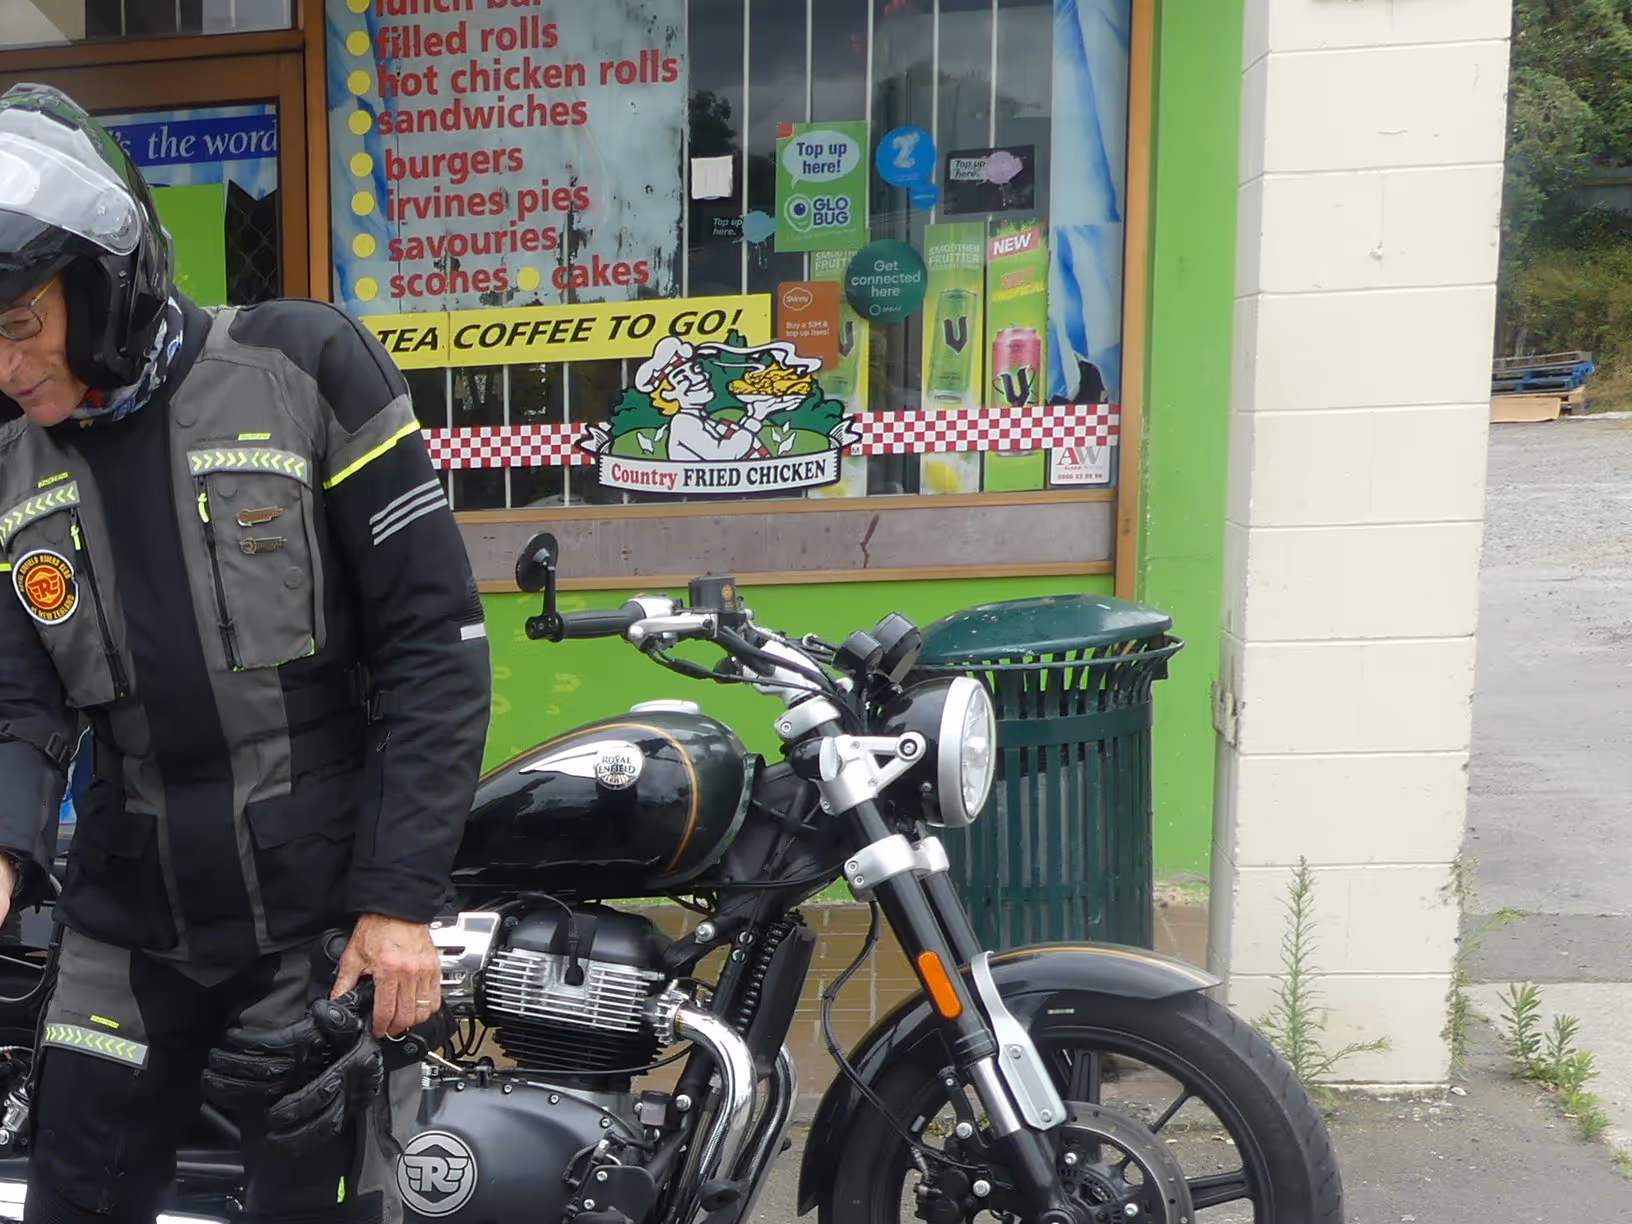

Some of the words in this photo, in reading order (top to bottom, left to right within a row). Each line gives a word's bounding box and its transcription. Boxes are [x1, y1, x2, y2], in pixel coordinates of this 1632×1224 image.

[376, 0, 473, 17] lun
[376, 20, 467, 60] filled
[481, 15, 558, 51] rolls
[377, 63, 438, 98] hot
[451, 57, 586, 94] chicken
[600, 49, 678, 86] rolls
[378, 94, 587, 136] sandwiches
[148, 125, 196, 159] the
[203, 119, 277, 155] word
[796, 142, 823, 158] Top
[829, 143, 847, 157] up
[385, 147, 524, 184] burgers
[802, 160, 841, 174] here!
[955, 160, 972, 169] Top
[973, 160, 986, 168] up
[386, 186, 504, 221] irvines
[518, 179, 589, 222] pies
[813, 197, 849, 211] GLO
[713, 217, 729, 228] Top
[731, 219, 743, 228] up
[813, 211, 849, 226] BUG
[388, 220, 557, 262] savouries
[993, 233, 1032, 256] NEW
[874, 260, 899, 271] Get
[390, 267, 508, 298] scones
[552, 255, 650, 289] cakes
[851, 271, 921, 286] connected
[871, 286, 900, 297] here
[375, 327, 438, 353] TEA
[453, 317, 596, 349] COFFEE
[608, 313, 656, 340] TO
[668, 308, 743, 336] GO!
[611, 463, 678, 490] Country
[682, 467, 741, 487] FRIED
[746, 459, 827, 486] CHICKEN
[598, 763, 636, 774] ENFIELD
[601, 755, 632, 765] ROYAL
